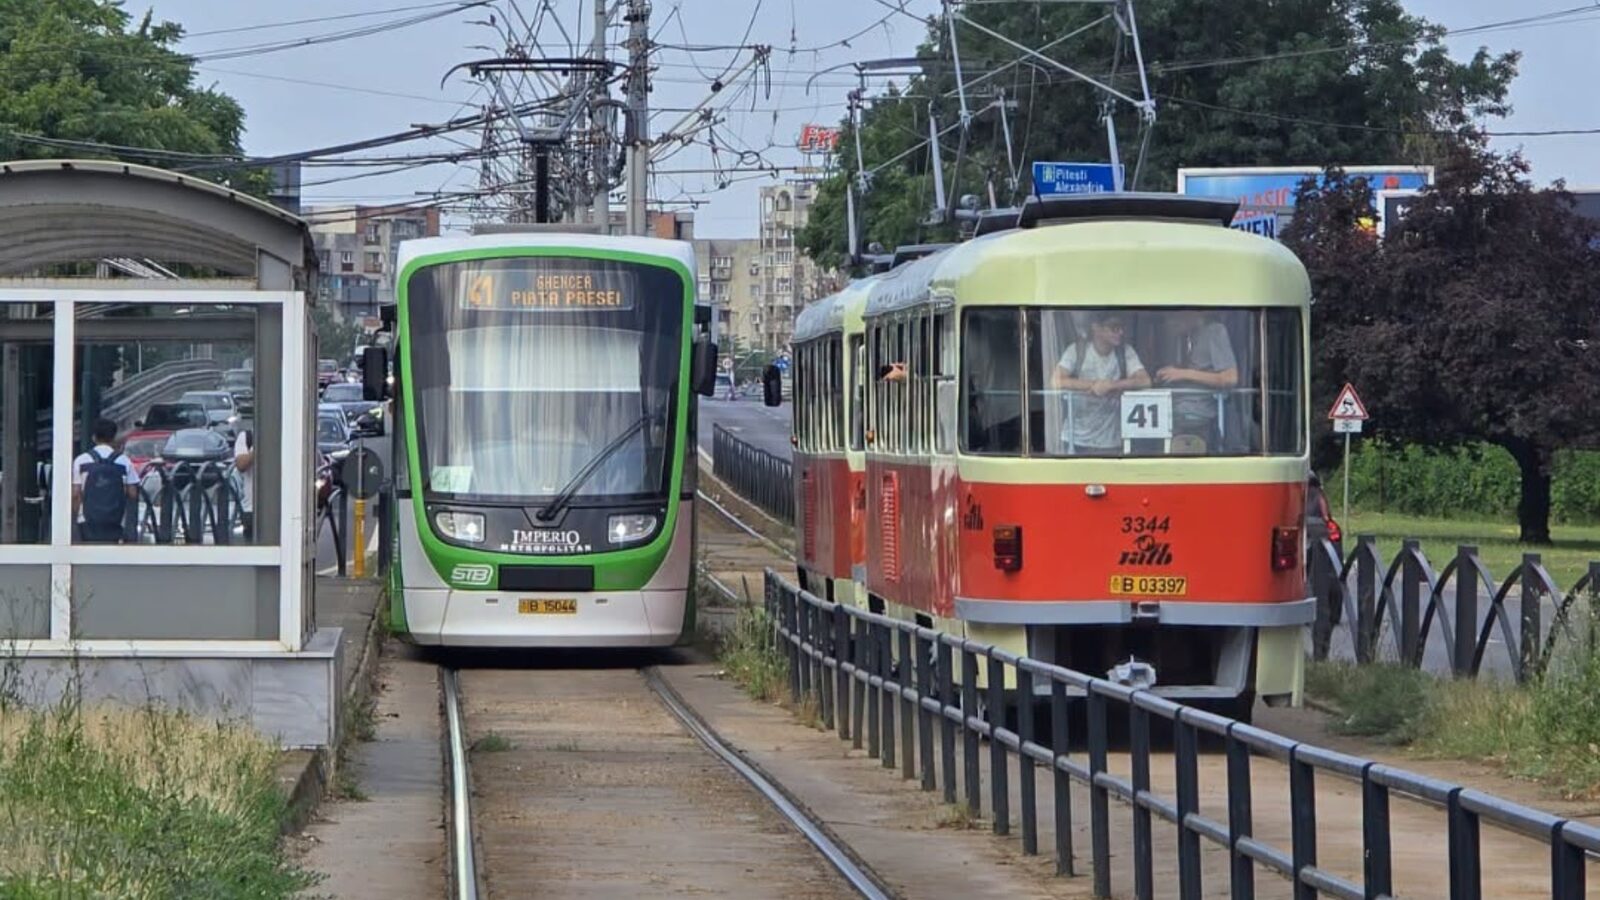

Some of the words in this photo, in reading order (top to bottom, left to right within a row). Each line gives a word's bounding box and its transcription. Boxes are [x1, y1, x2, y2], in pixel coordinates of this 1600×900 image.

[469, 275, 495, 306] 41
[566, 291, 620, 305] PRESEI
[1127, 403, 1159, 428] 41
[1121, 515, 1170, 533] 3344
[512, 529, 580, 545] IMPERIO
[500, 543, 592, 552] METROPOLITAN
[451, 567, 489, 580] STB
[1122, 577, 1134, 593] B
[1138, 577, 1185, 593] 03397
[529, 600, 538, 612] B
